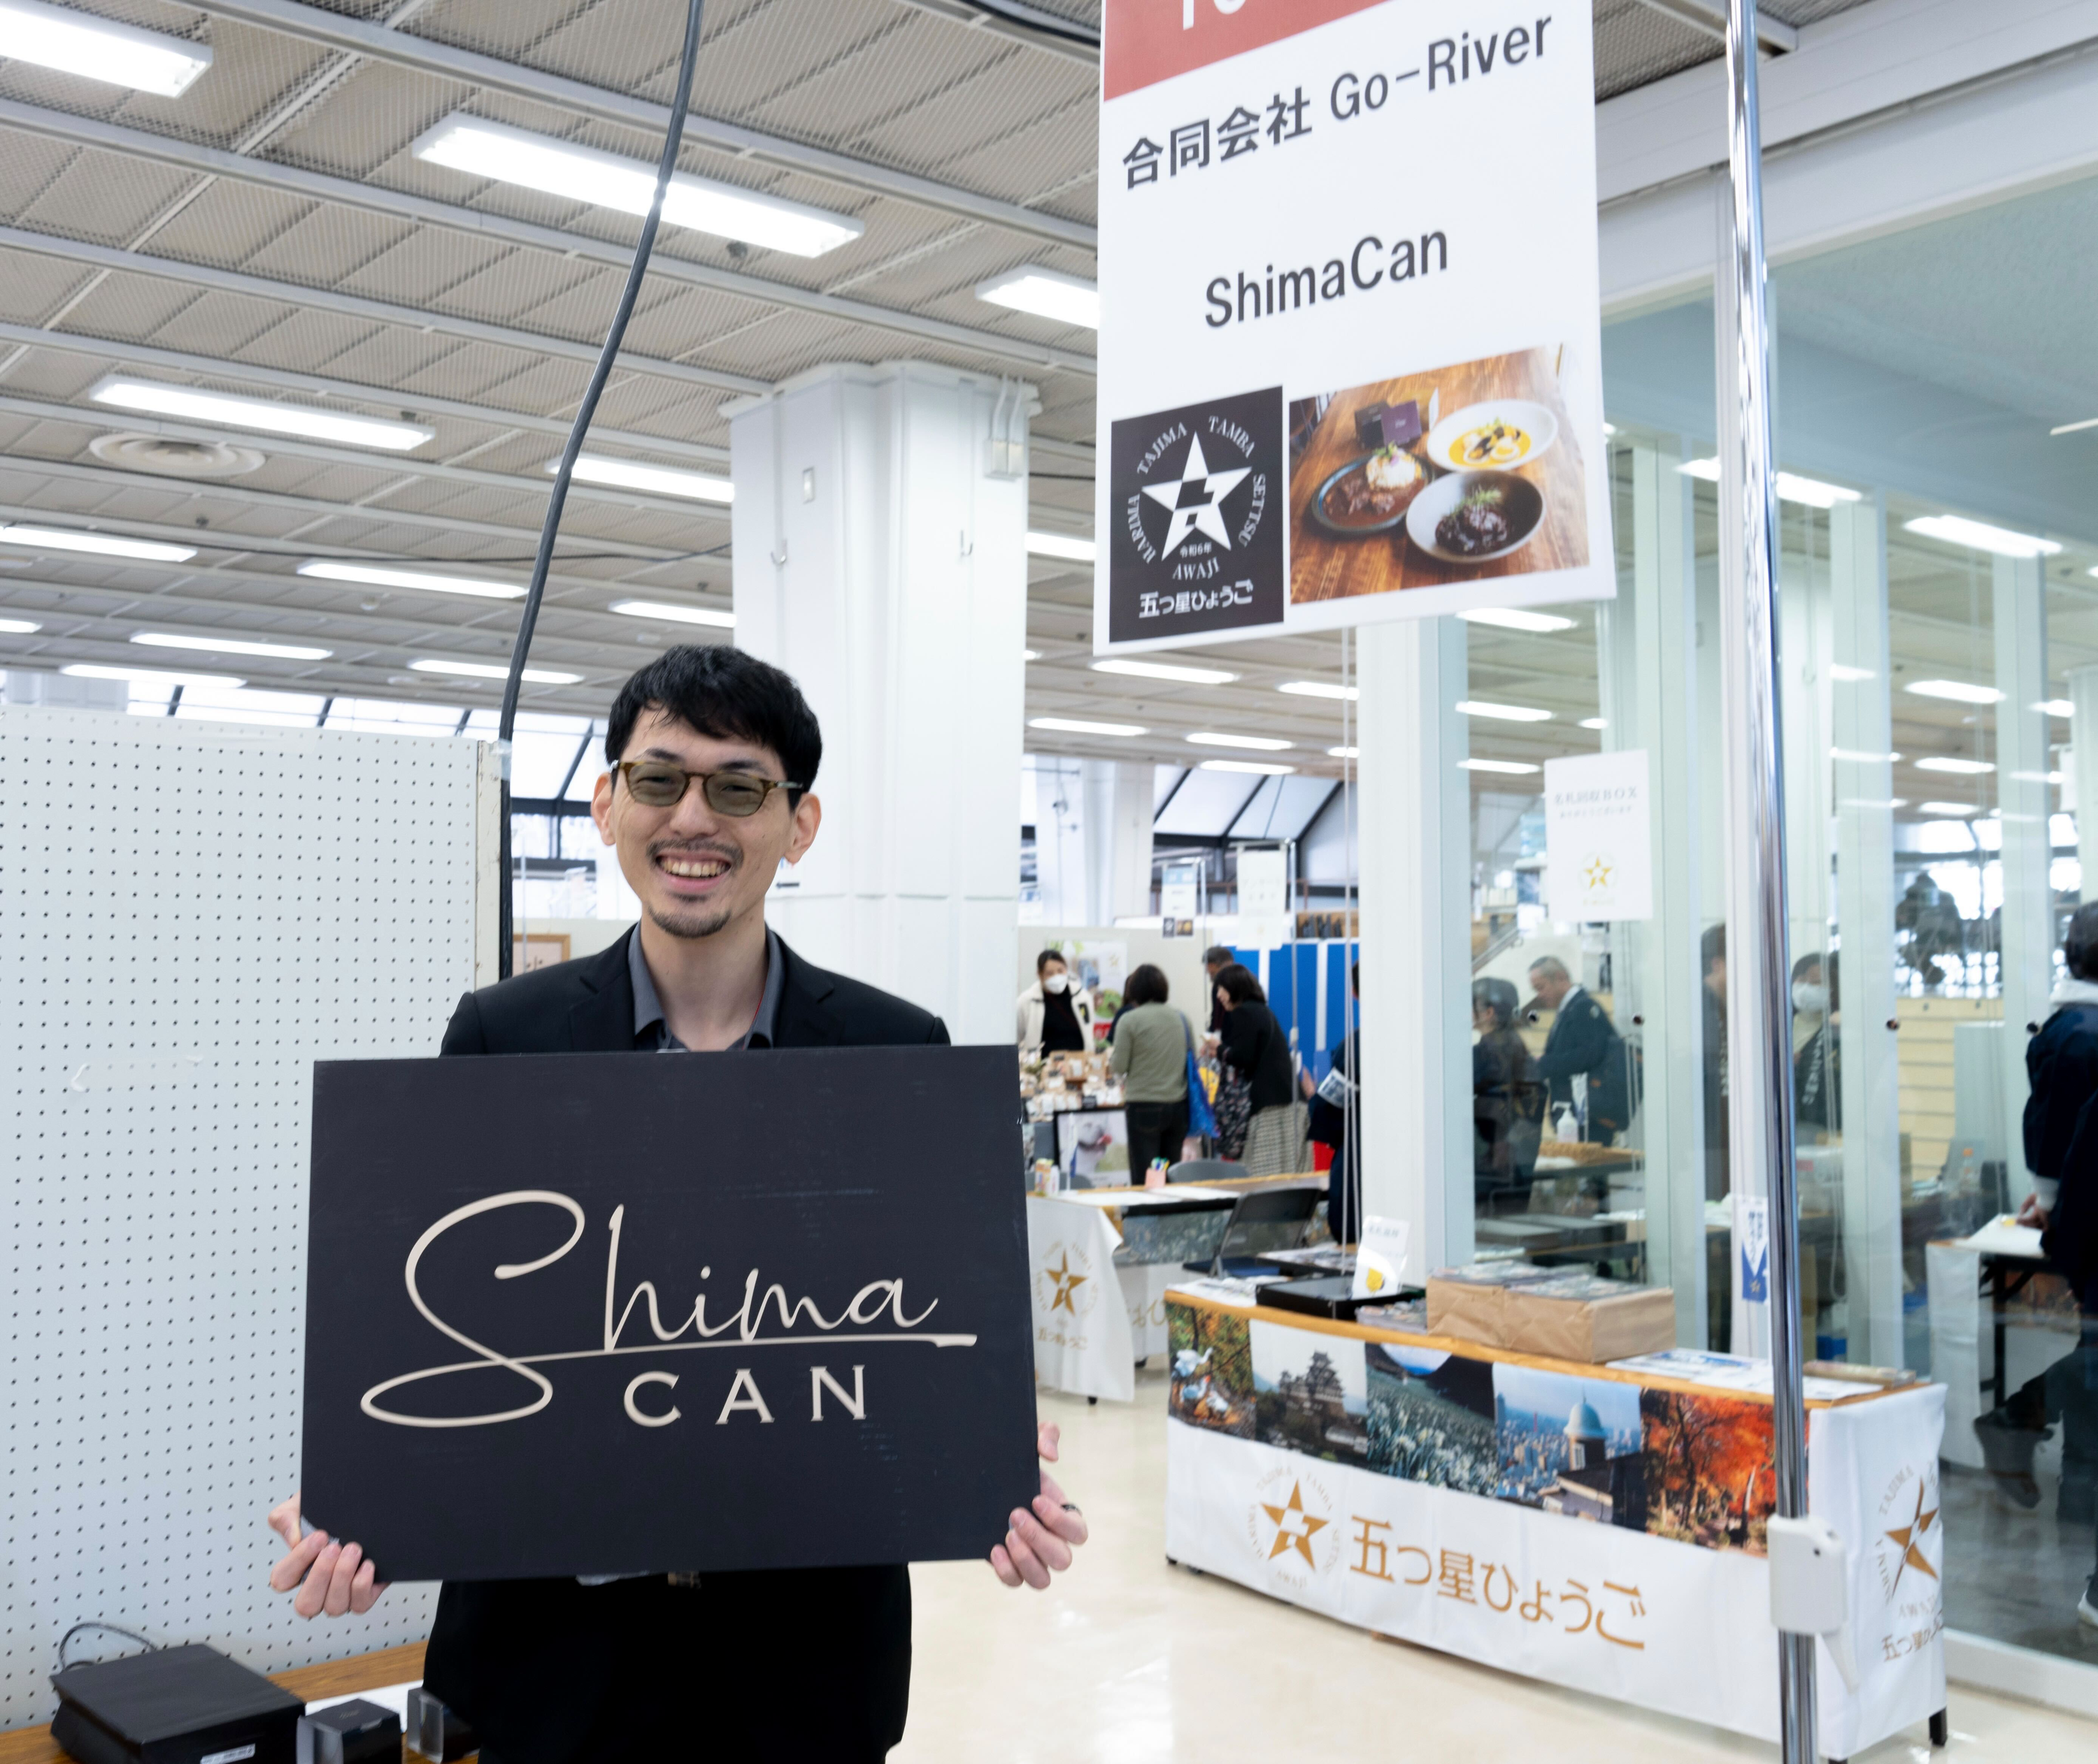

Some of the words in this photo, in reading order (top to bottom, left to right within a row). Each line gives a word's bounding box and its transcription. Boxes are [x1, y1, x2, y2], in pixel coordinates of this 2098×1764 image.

[1122, 85, 1313, 190] 合同会社
[1204, 230, 1448, 328] ShimaCan
[1136, 421, 1188, 476] TAJIMA
[1208, 415, 1255, 459] TAMBA
[1127, 493, 1157, 564] HARIMA
[1238, 473, 1266, 548] SETTSU
[1139, 578, 1254, 619] 五つ星ひょうご
[1172, 556, 1220, 581] AWAJI
[360, 1189, 978, 1428] Shima
[622, 1365, 868, 1428] CAN
[1350, 1515, 1646, 1650] 五つ星ひょうご
